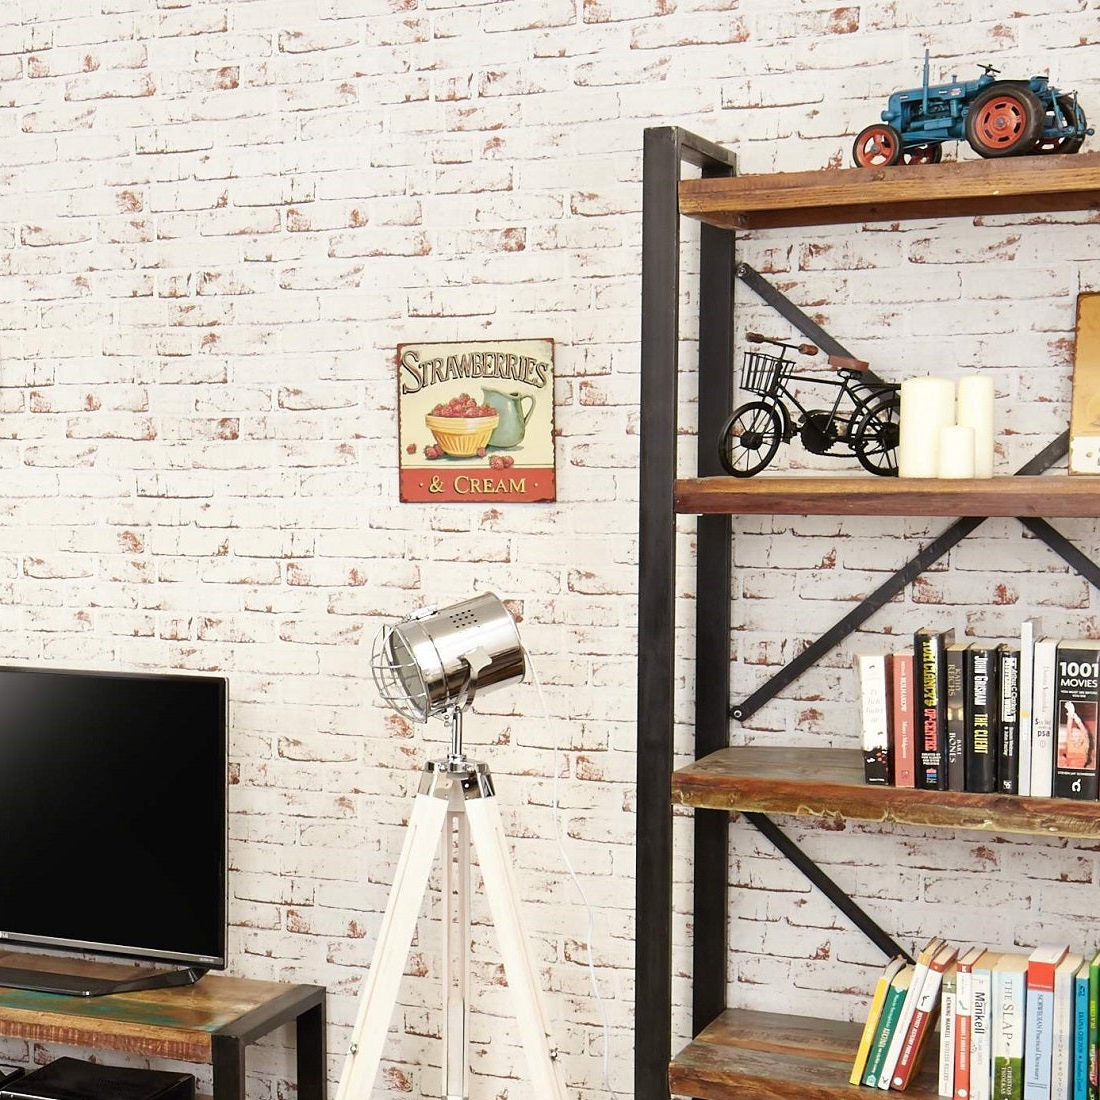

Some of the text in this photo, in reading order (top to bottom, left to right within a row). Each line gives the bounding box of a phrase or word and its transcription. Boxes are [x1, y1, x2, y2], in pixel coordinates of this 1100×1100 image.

[402, 350, 550, 394] STRAWBERRIES
[429, 475, 526, 493] & CREAM
[923, 640, 937, 662] TOM
[1060, 662, 1099, 676] 1001
[1060, 679, 1098, 688] MOVIES
[974, 656, 988, 754] JOHN GRISHAM THE CLIENT
[925, 708, 937, 751] OP-CENTRE
[974, 992, 985, 1034] Mankell
[1002, 980, 1013, 1039] THE SLAP
